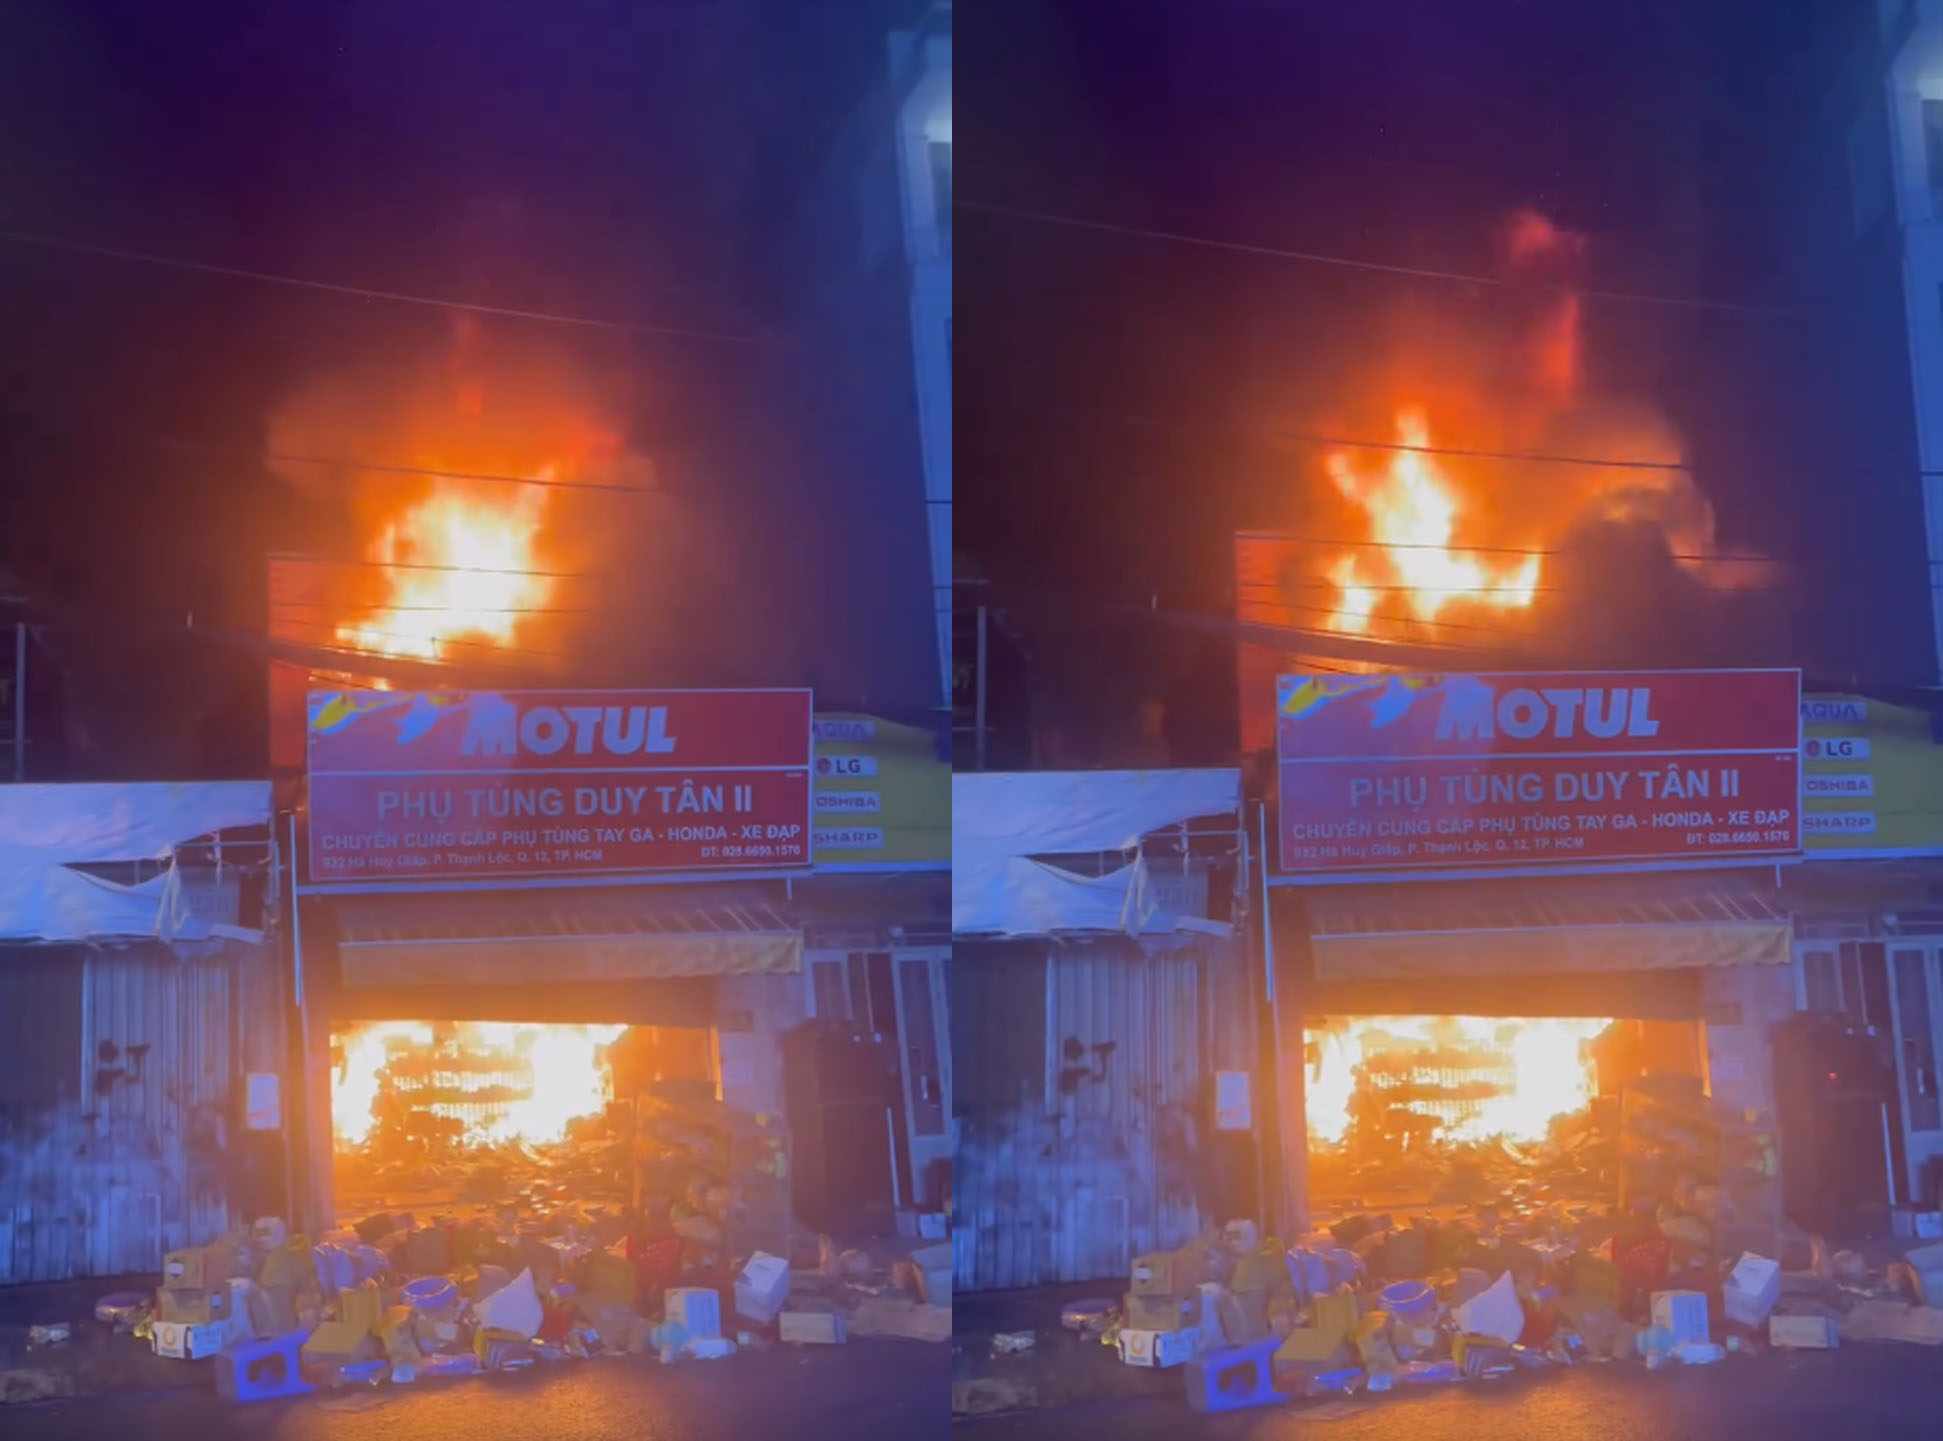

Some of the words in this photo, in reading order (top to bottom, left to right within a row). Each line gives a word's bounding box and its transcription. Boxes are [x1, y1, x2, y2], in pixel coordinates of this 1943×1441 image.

[1435, 676, 1660, 739] MOTUL
[460, 692, 677, 756] MOTUL
[1826, 741, 1853, 756] LG
[836, 759, 861, 774] LG
[1350, 777, 1428, 813] PHỤ
[1440, 768, 1544, 804] TÙNG
[1555, 772, 1629, 802] DUY
[1638, 763, 1710, 799] TÂN
[1806, 780, 1870, 791] OSHIBA
[377, 791, 453, 825] PHỤ
[465, 783, 565, 818] TÙNG
[575, 787, 646, 816] DUY
[655, 779, 724, 814] TÂN
[815, 796, 876, 808] OSHIBA
[1292, 818, 1372, 839] CHUYÊN
[1378, 820, 1431, 836] CUNG
[1480, 817, 1516, 835] PHỤ
[1577, 815, 1606, 830] TAY
[1612, 814, 1637, 829] GA
[1653, 812, 1713, 828] HONDA
[1728, 811, 1749, 826] XE
[1755, 809, 1790, 827] ĐẠP
[1803, 817, 1871, 830] SHARP
[322, 830, 398, 849] CHUYÊN
[403, 832, 456, 847] CUNG
[502, 830, 537, 848] PHỤ
[595, 828, 624, 843] TAY
[629, 828, 654, 842] GA
[668, 826, 727, 842] HONDA
[741, 825, 762, 840] XE
[767, 824, 800, 842] ĐẠP
[814, 832, 878, 845] SHARP
[1553, 837, 1584, 850] HCM
[575, 849, 603, 862] HCM
